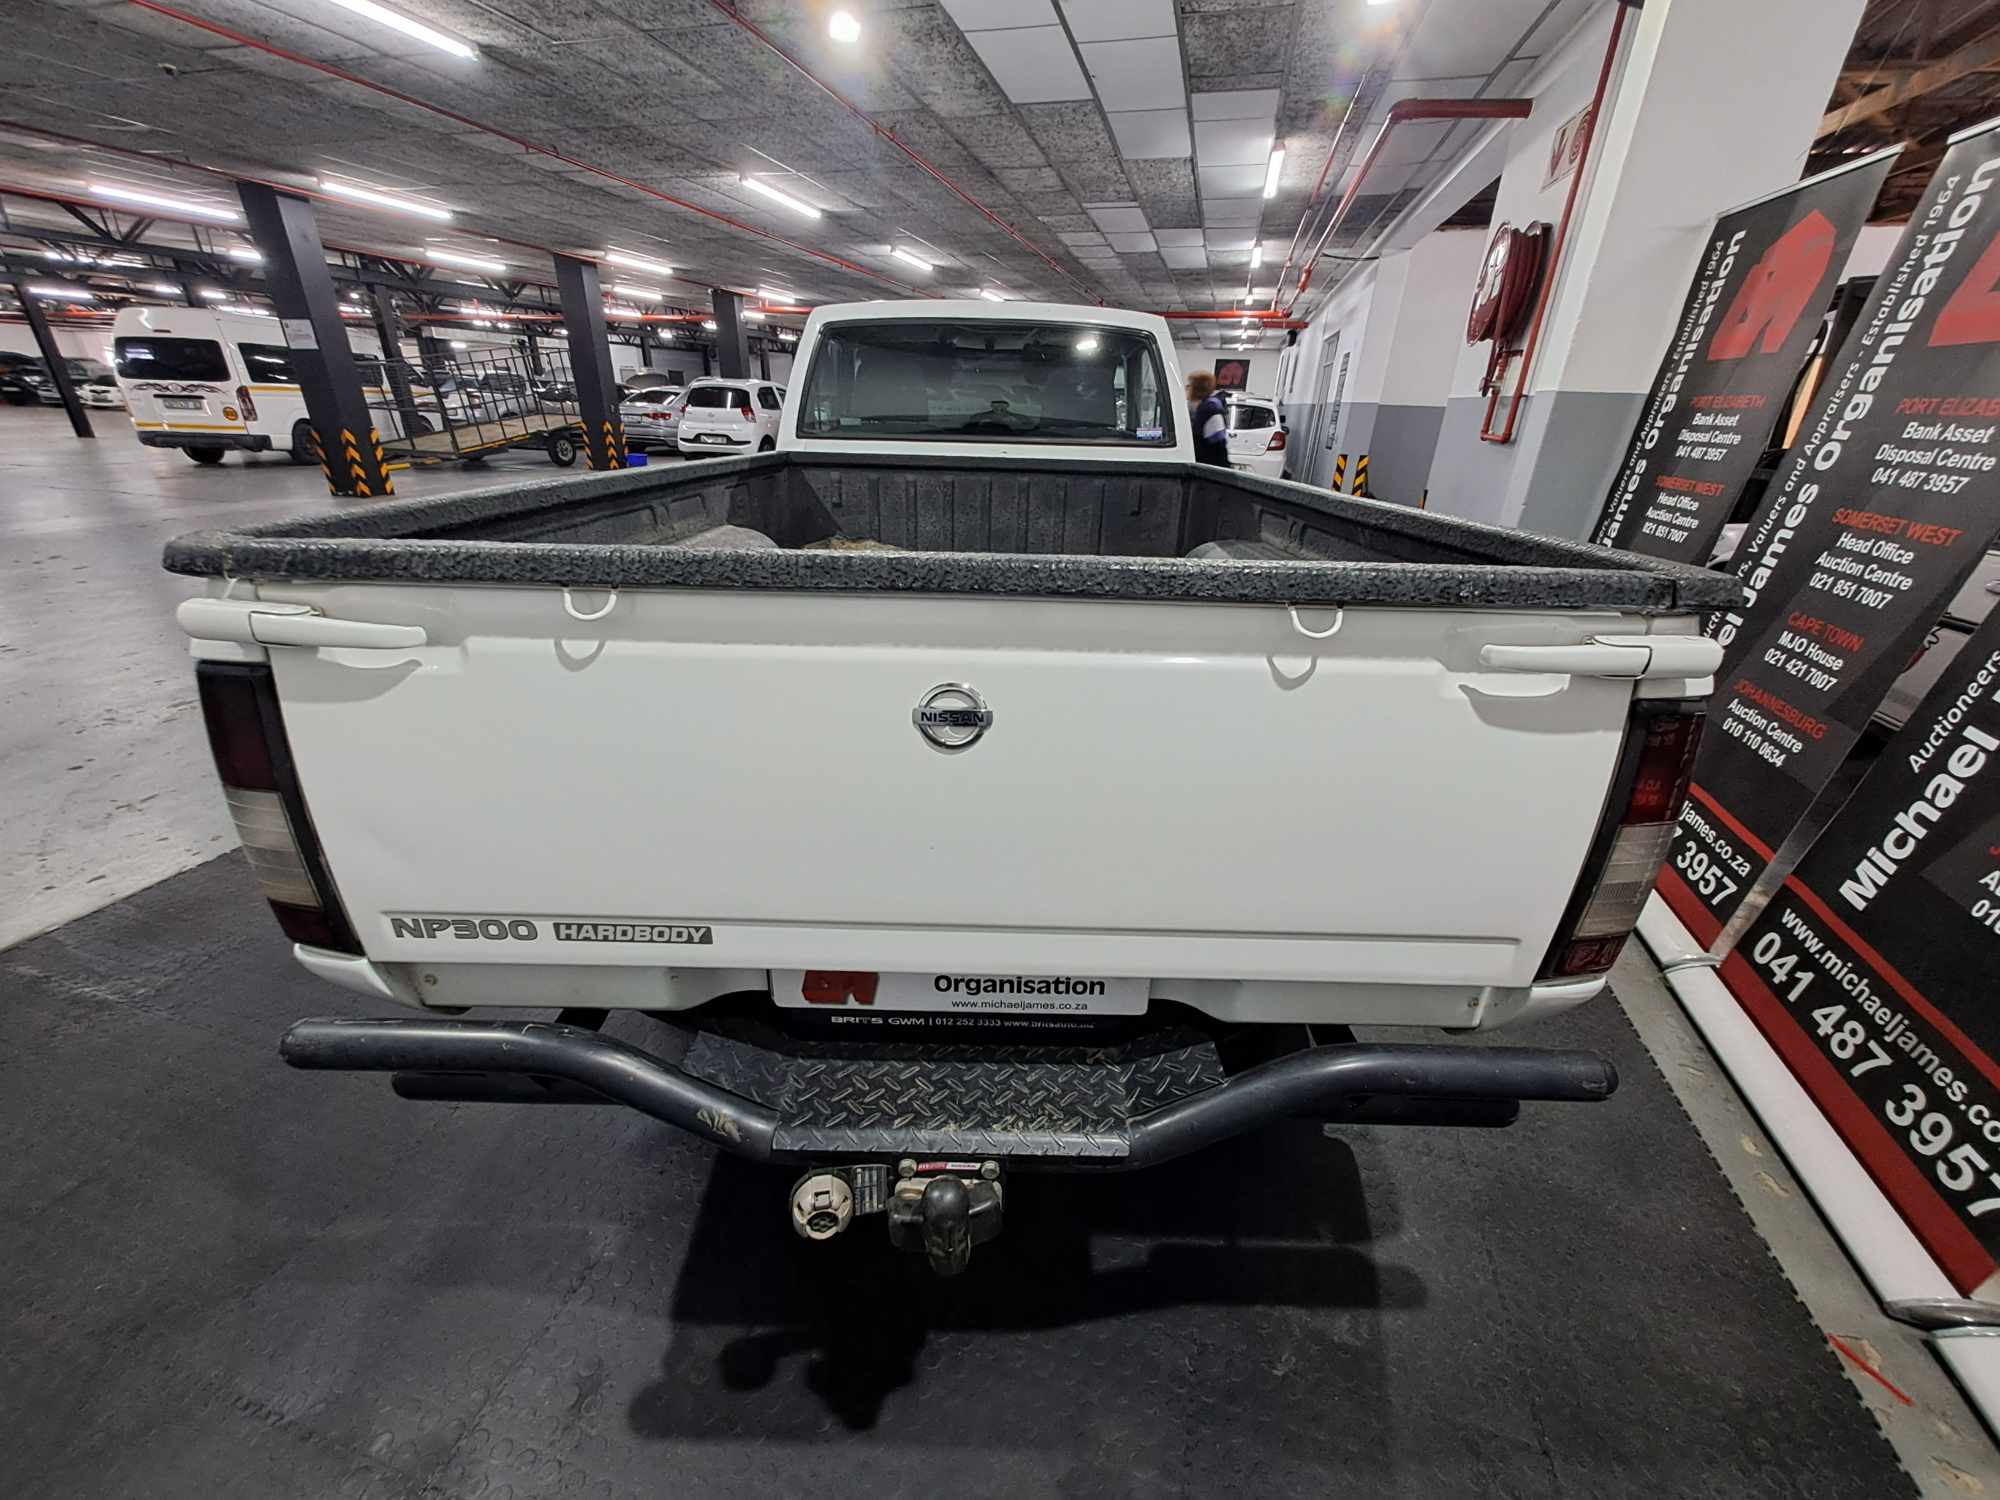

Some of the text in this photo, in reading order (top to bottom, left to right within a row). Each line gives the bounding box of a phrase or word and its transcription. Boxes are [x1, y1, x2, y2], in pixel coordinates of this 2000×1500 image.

[1608, 469, 1631, 513] Valuers
[1629, 441, 1642, 467] and
[1672, 281, 1710, 361] Established
[1705, 241, 1724, 277] 1964
[1747, 495, 1787, 553] Valuers
[1785, 458, 1808, 492] and
[1803, 362, 1860, 456] Appraisers
[1862, 234, 1931, 346] Established
[1923, 175, 1961, 228] 1964
[1602, 230, 1747, 548] James Organisation
[1742, 483, 1819, 608] James
[1813, 158, 2000, 471] Organisation
[1678, 429, 1742, 445] Disposal Centre
[1692, 413, 1741, 426] Bank Asset
[1901, 421, 1996, 444] Bank Asset
[1875, 444, 1997, 471] Disposal Centre
[1871, 467, 1971, 495] 041 487 3957
[1645, 506, 1699, 528] Auction Centre
[1657, 492, 1700, 510] Head Office
[1832, 508, 1966, 545] SOMERSET WEST
[1836, 532, 1915, 564] Head Office
[1815, 551, 1913, 591] Auction Centre
[1809, 572, 1894, 609] 021 851 7007
[1777, 630, 1844, 671] MJO House
[1788, 612, 1865, 653] CAPE TOWN
[1764, 648, 1838, 691] 021 421 7007
[920, 710, 985, 723] NISSAN
[1728, 698, 1803, 753] Auction Centre
[1722, 717, 1787, 768] 010 110 0634
[1838, 725, 2000, 912] Michael
[1676, 840, 1738, 906] 3957
[389, 918, 707, 943] NP300 HARDBODY
[934, 974, 1106, 996] Organisation
[888, 1017, 925, 1026] GWM
[935, 1018, 954, 1026] 012
[951, 999, 1088, 1012] www.michaeljames.co.za
[1752, 931, 1815, 1002] 041
[1811, 1004, 1895, 1078] 487
